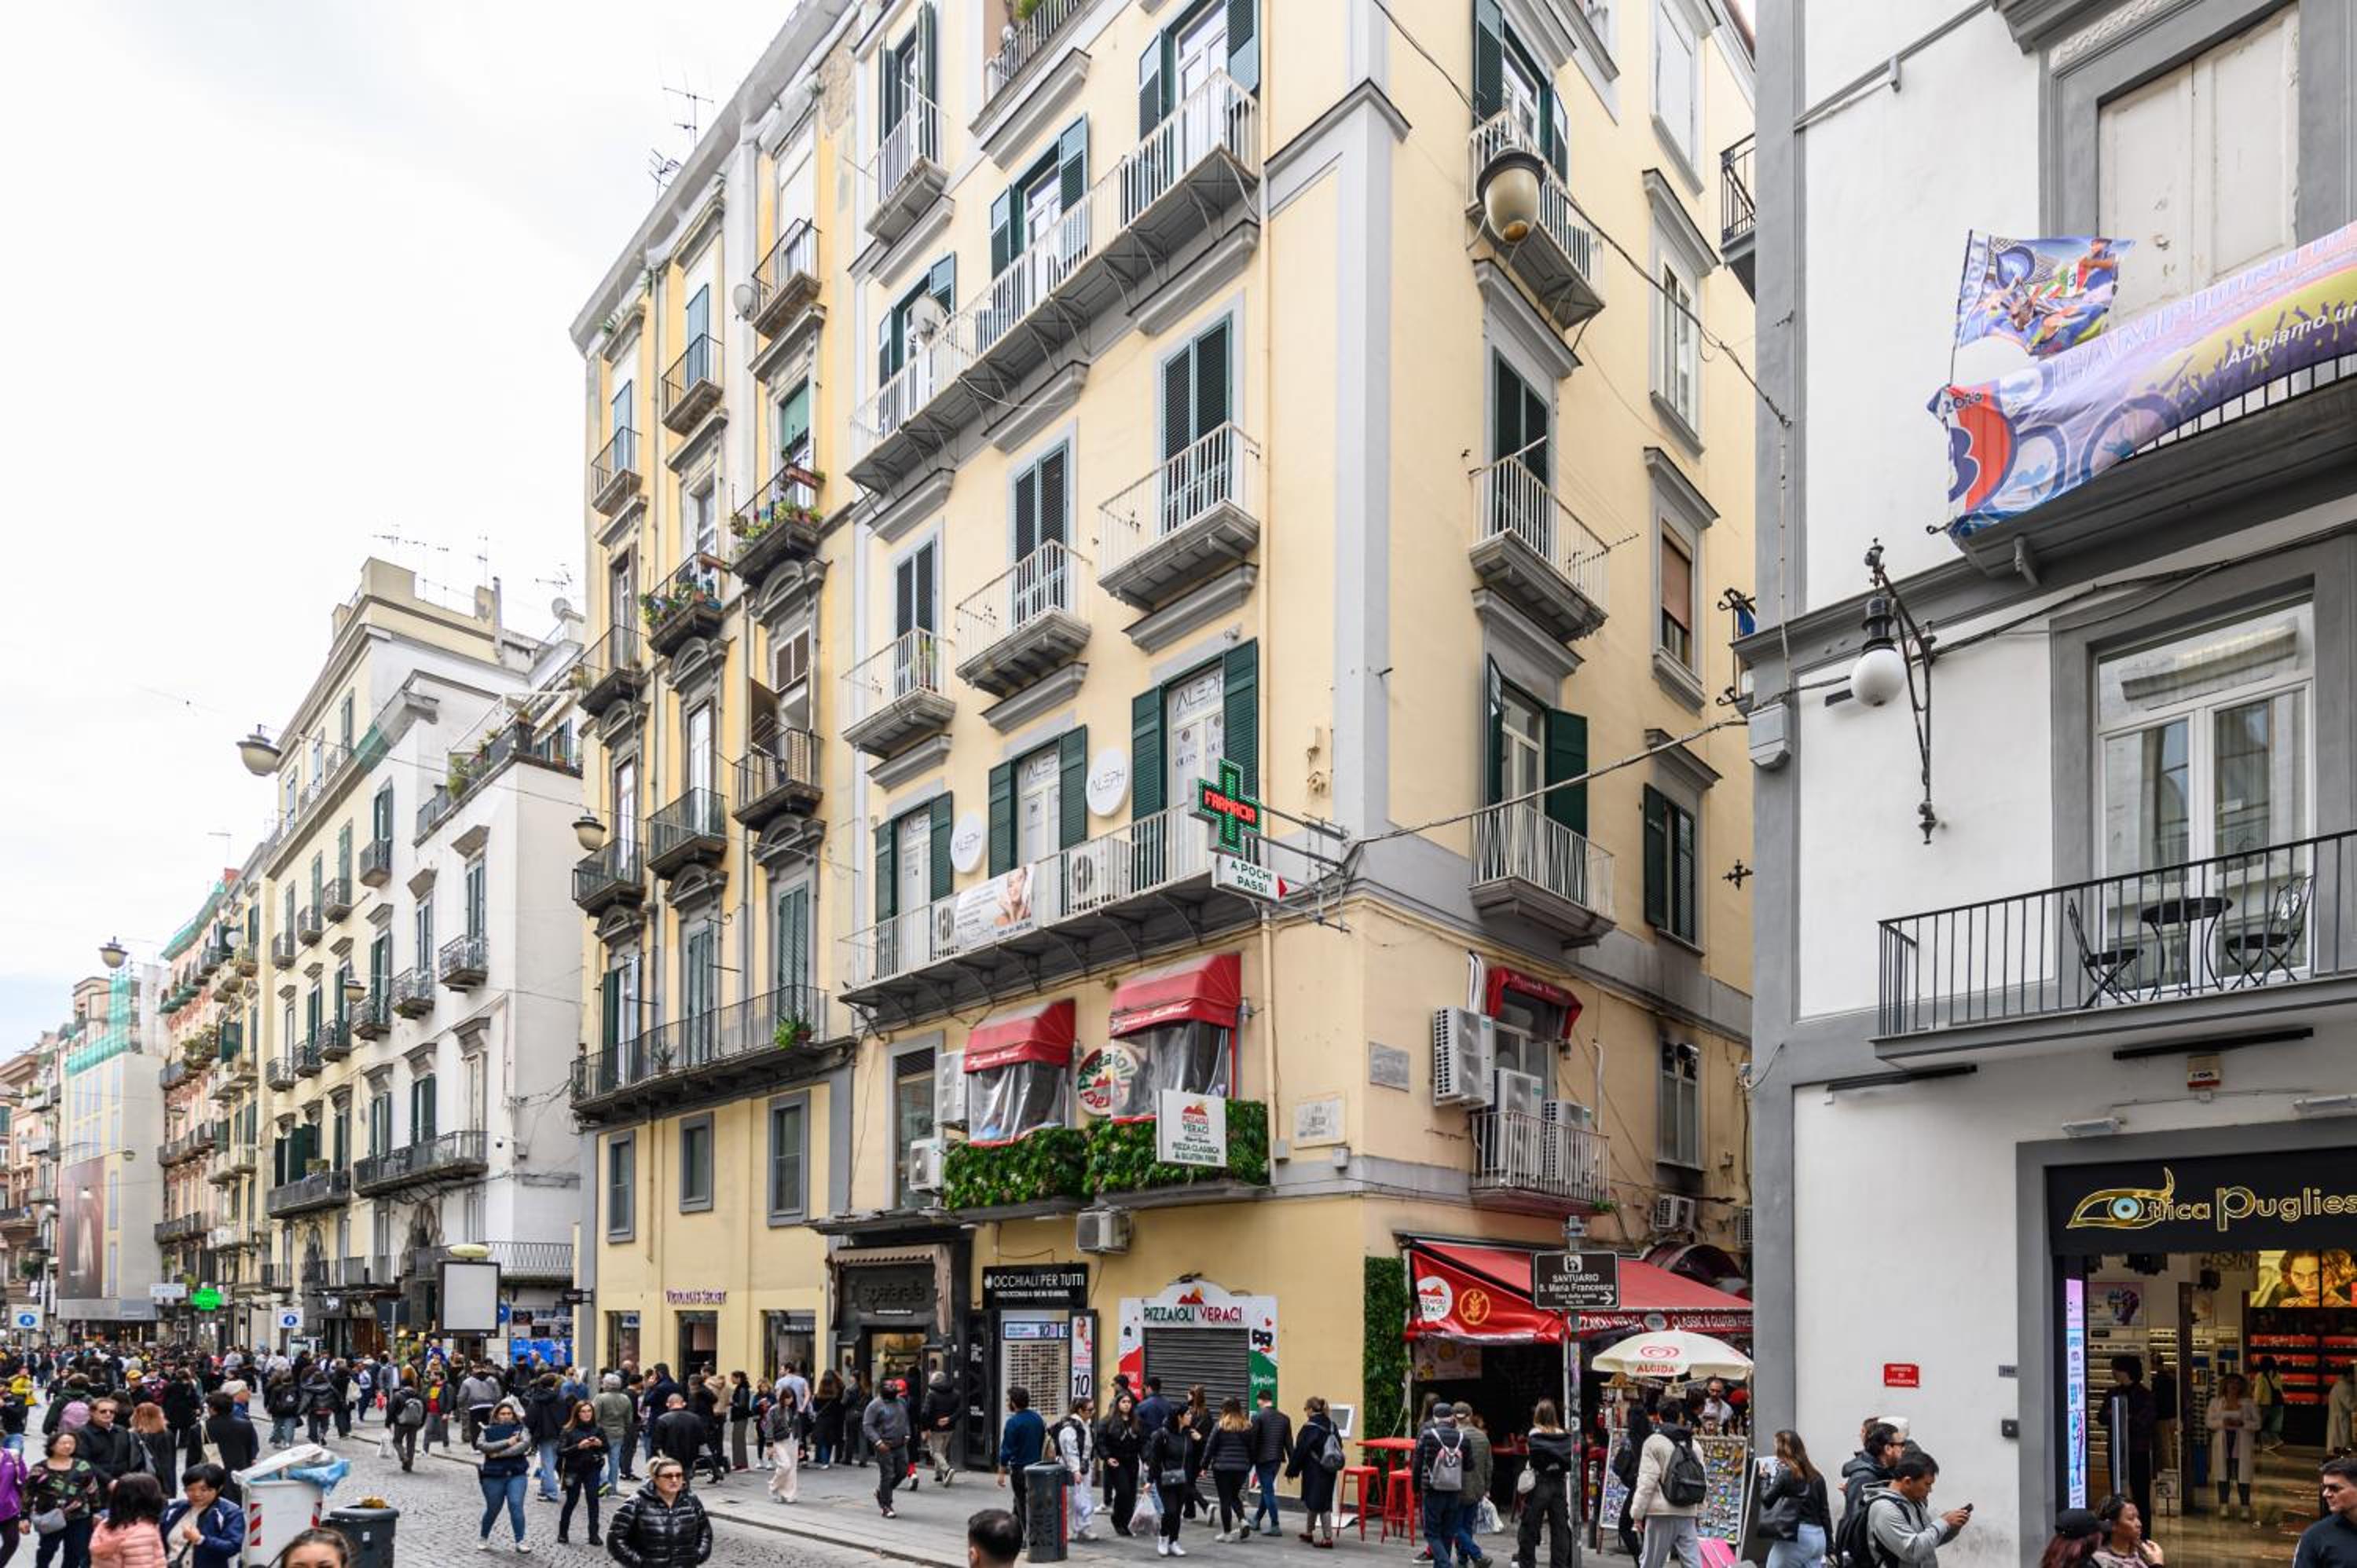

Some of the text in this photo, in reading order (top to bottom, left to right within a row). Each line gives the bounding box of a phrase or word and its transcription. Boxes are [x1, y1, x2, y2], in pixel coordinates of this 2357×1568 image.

[2224, 315, 2327, 369] Abbiamo
[1204, 789, 1256, 823] FARMACIA
[1230, 859, 1272, 882] A POCHI
[1237, 875, 1267, 895] PASSI
[1172, 1141, 1190, 1151] PIZZA
[993, 1273, 1084, 1288] OCCHIALI PER TUTTI
[1552, 1274, 1599, 1283] SANTUARIO
[1549, 1283, 1570, 1292] Maria
[1571, 1283, 1615, 1292] Francesca
[1143, 1306, 1242, 1322] PIZZAIOLI VERACI
[1636, 1363, 1676, 1373] ALGIDA
[1074, 1374, 1090, 1397] 10
